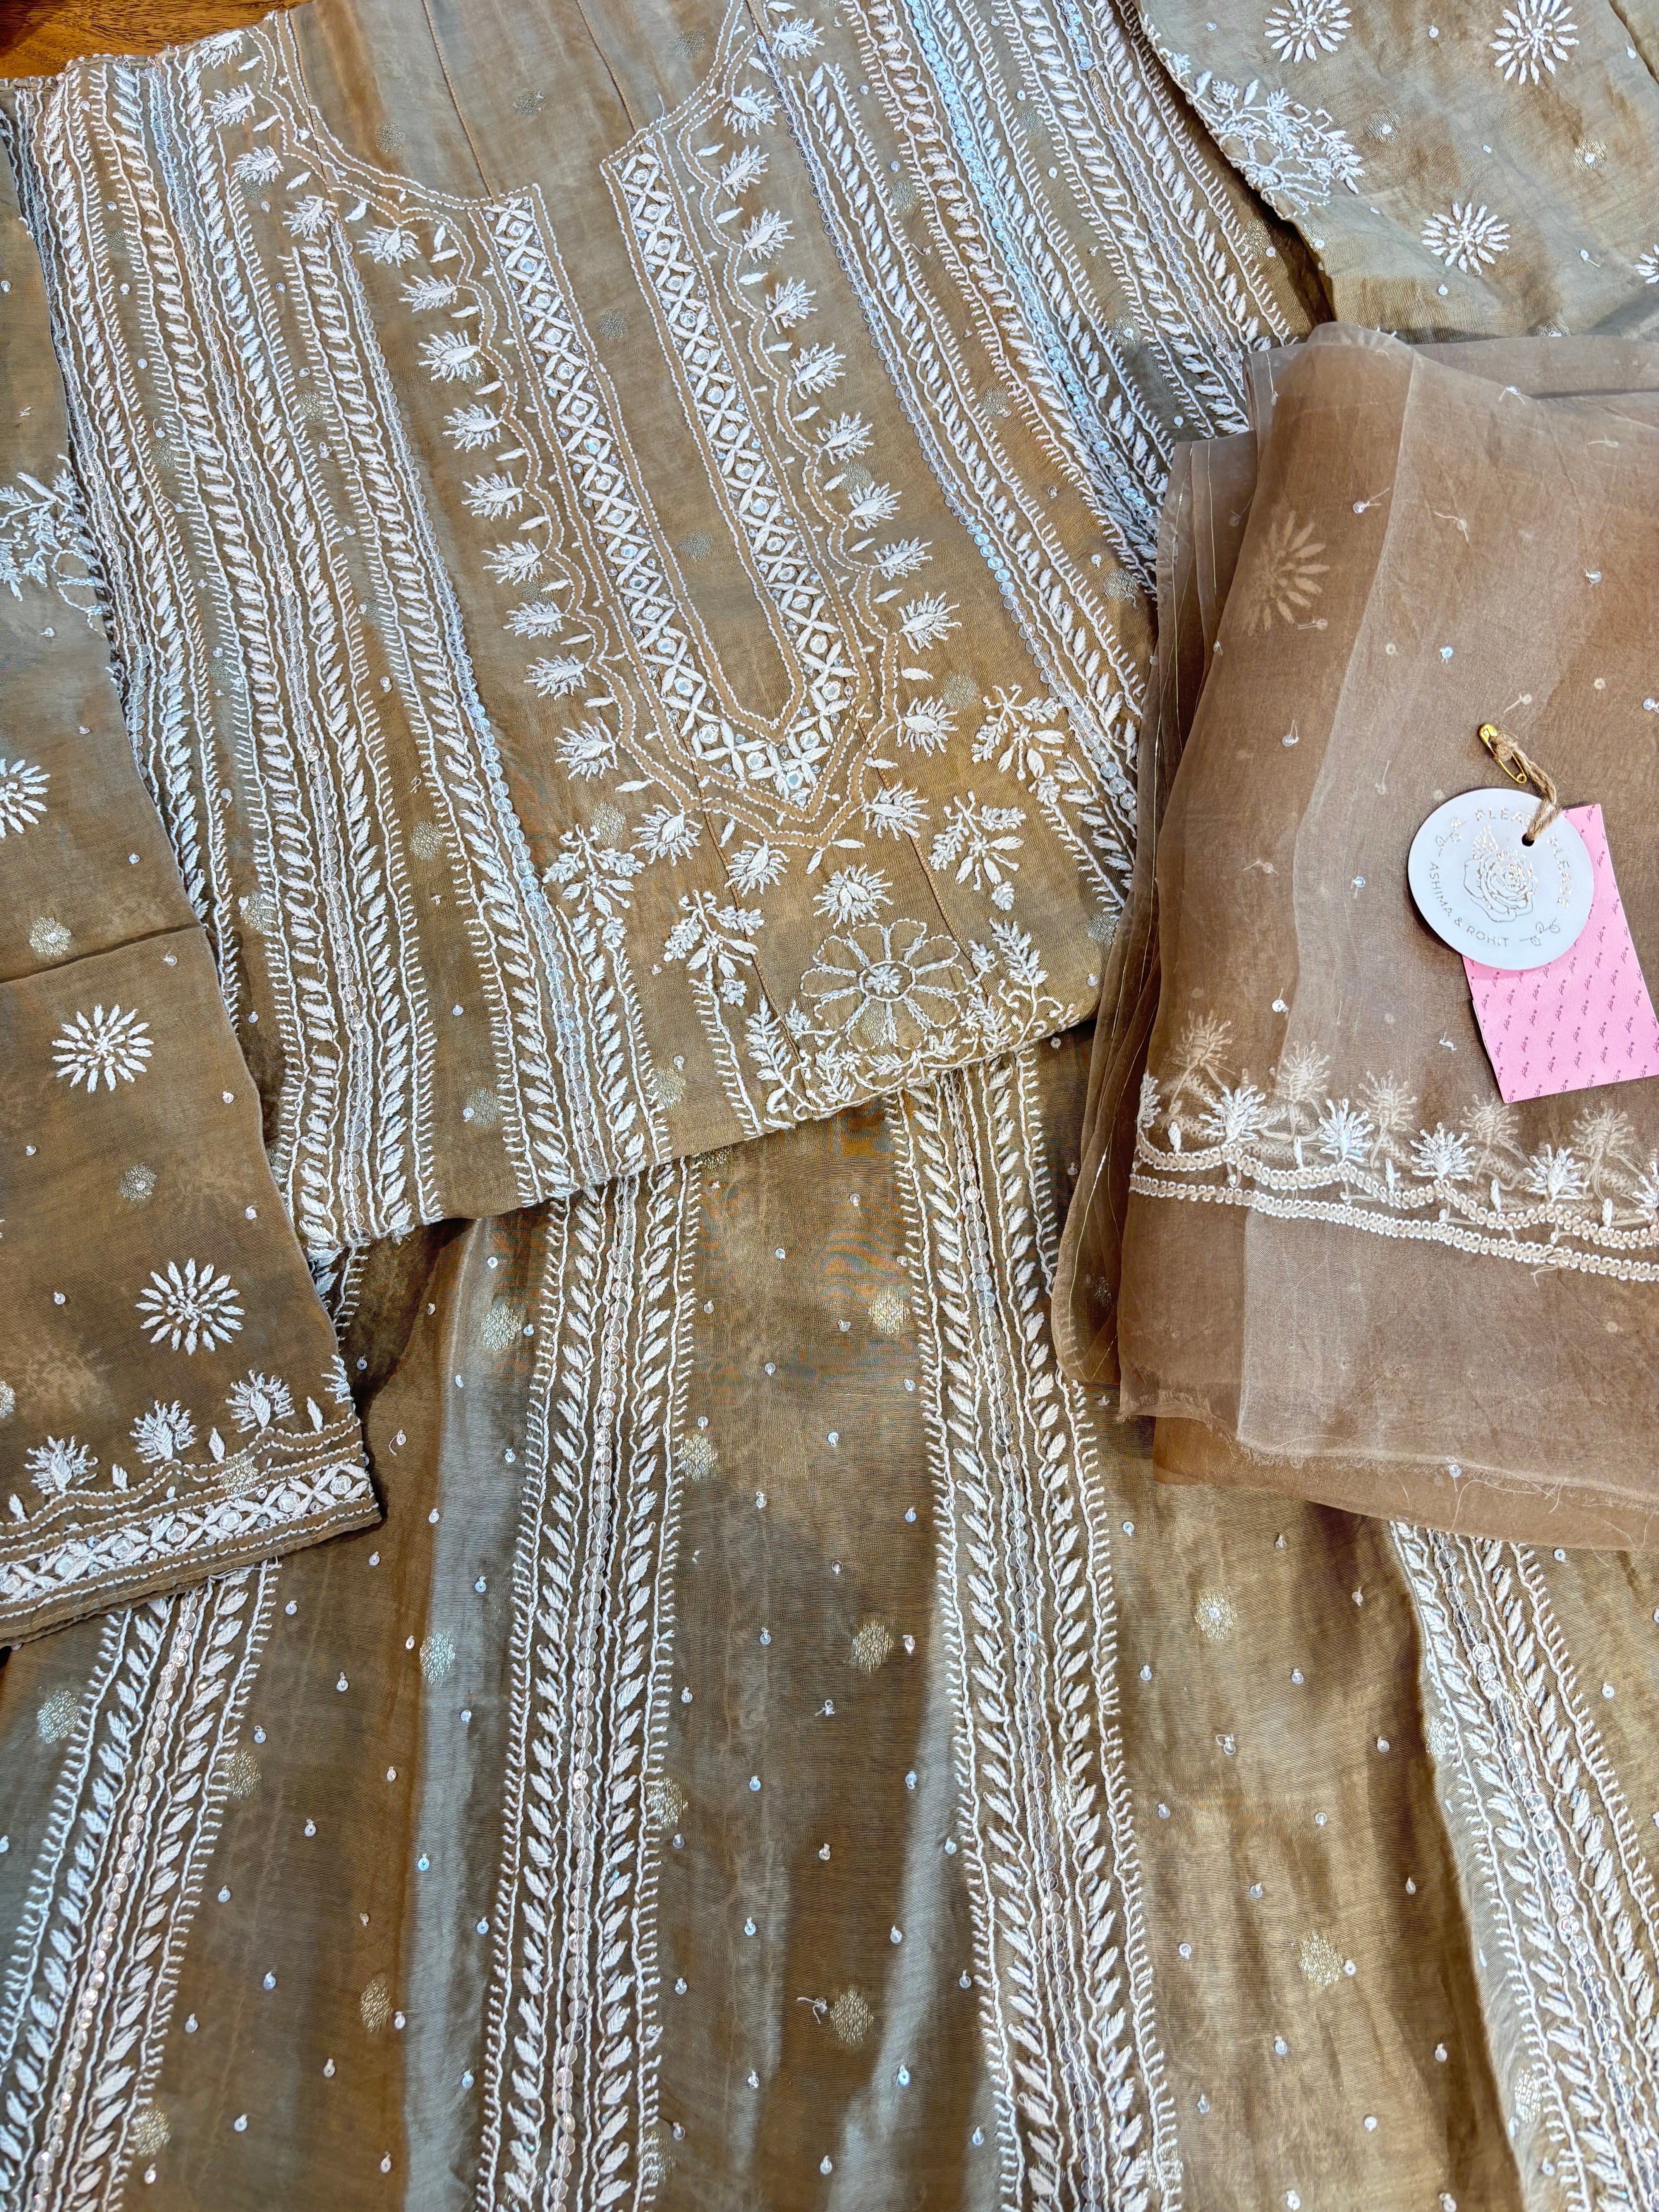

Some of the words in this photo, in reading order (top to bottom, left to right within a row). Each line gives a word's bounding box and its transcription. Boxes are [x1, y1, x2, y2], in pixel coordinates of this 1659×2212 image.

[1429, 862, 1452, 917] ASHIMA
[1455, 917, 1462, 927] &
[1467, 926, 1509, 947] ROHIT
[1546, 835, 1571, 907] PLEASE
